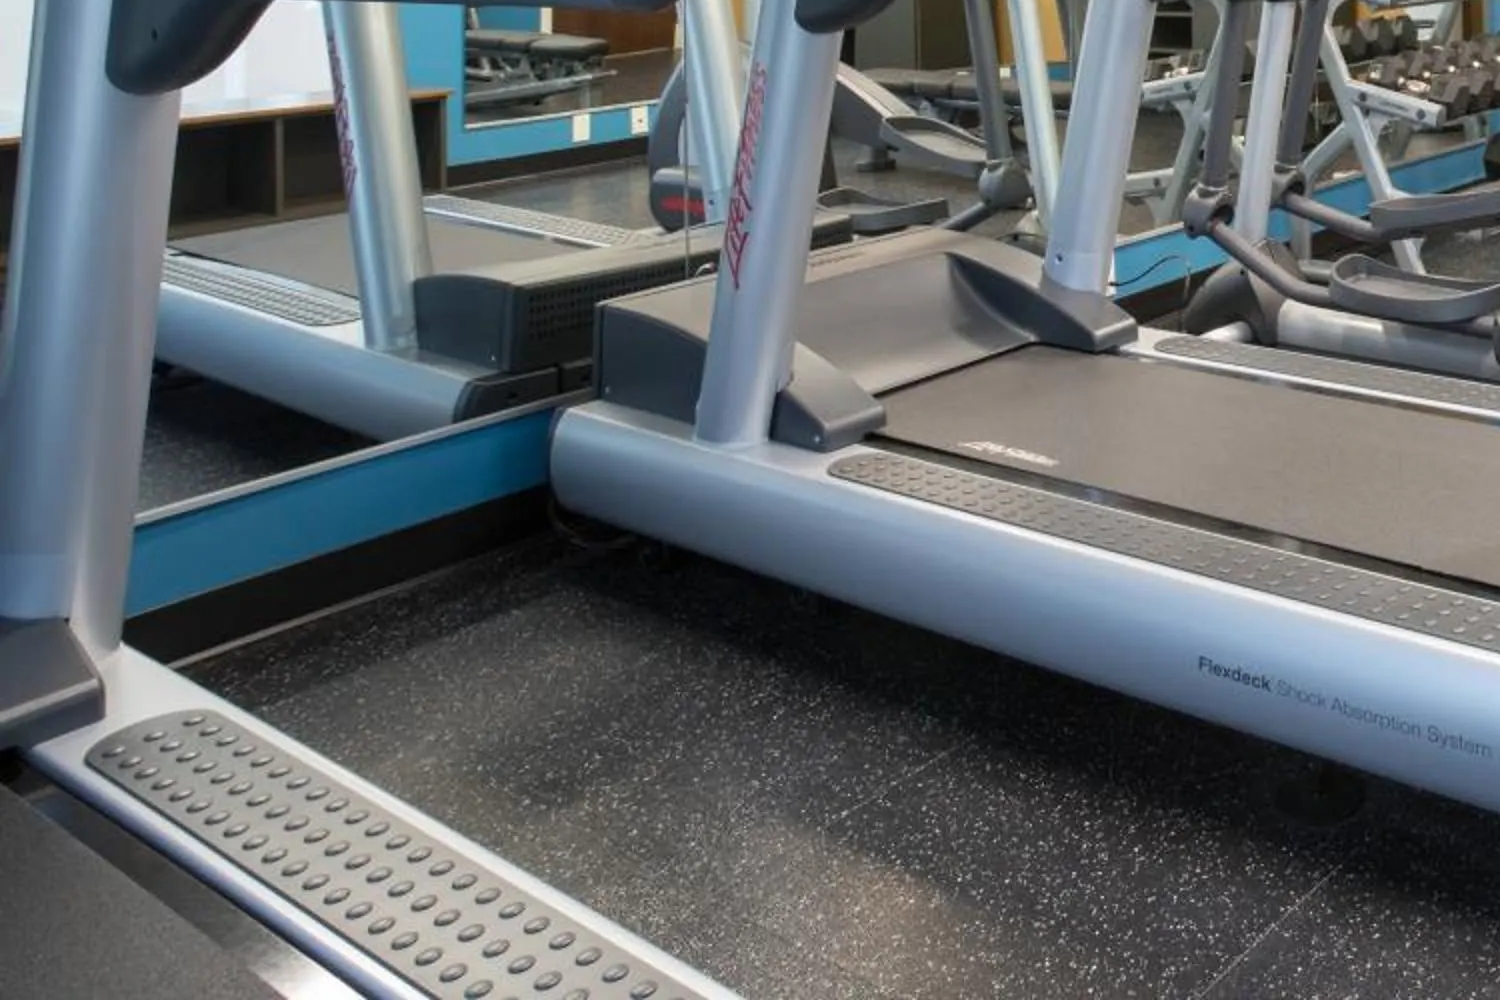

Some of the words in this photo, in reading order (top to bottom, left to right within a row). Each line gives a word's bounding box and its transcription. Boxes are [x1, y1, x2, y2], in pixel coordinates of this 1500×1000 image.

[1199, 655, 1271, 693] Flexdeck
[1275, 679, 1326, 709] Shock
[1331, 697, 1422, 739] Absorption
[1427, 726, 1493, 757] System
